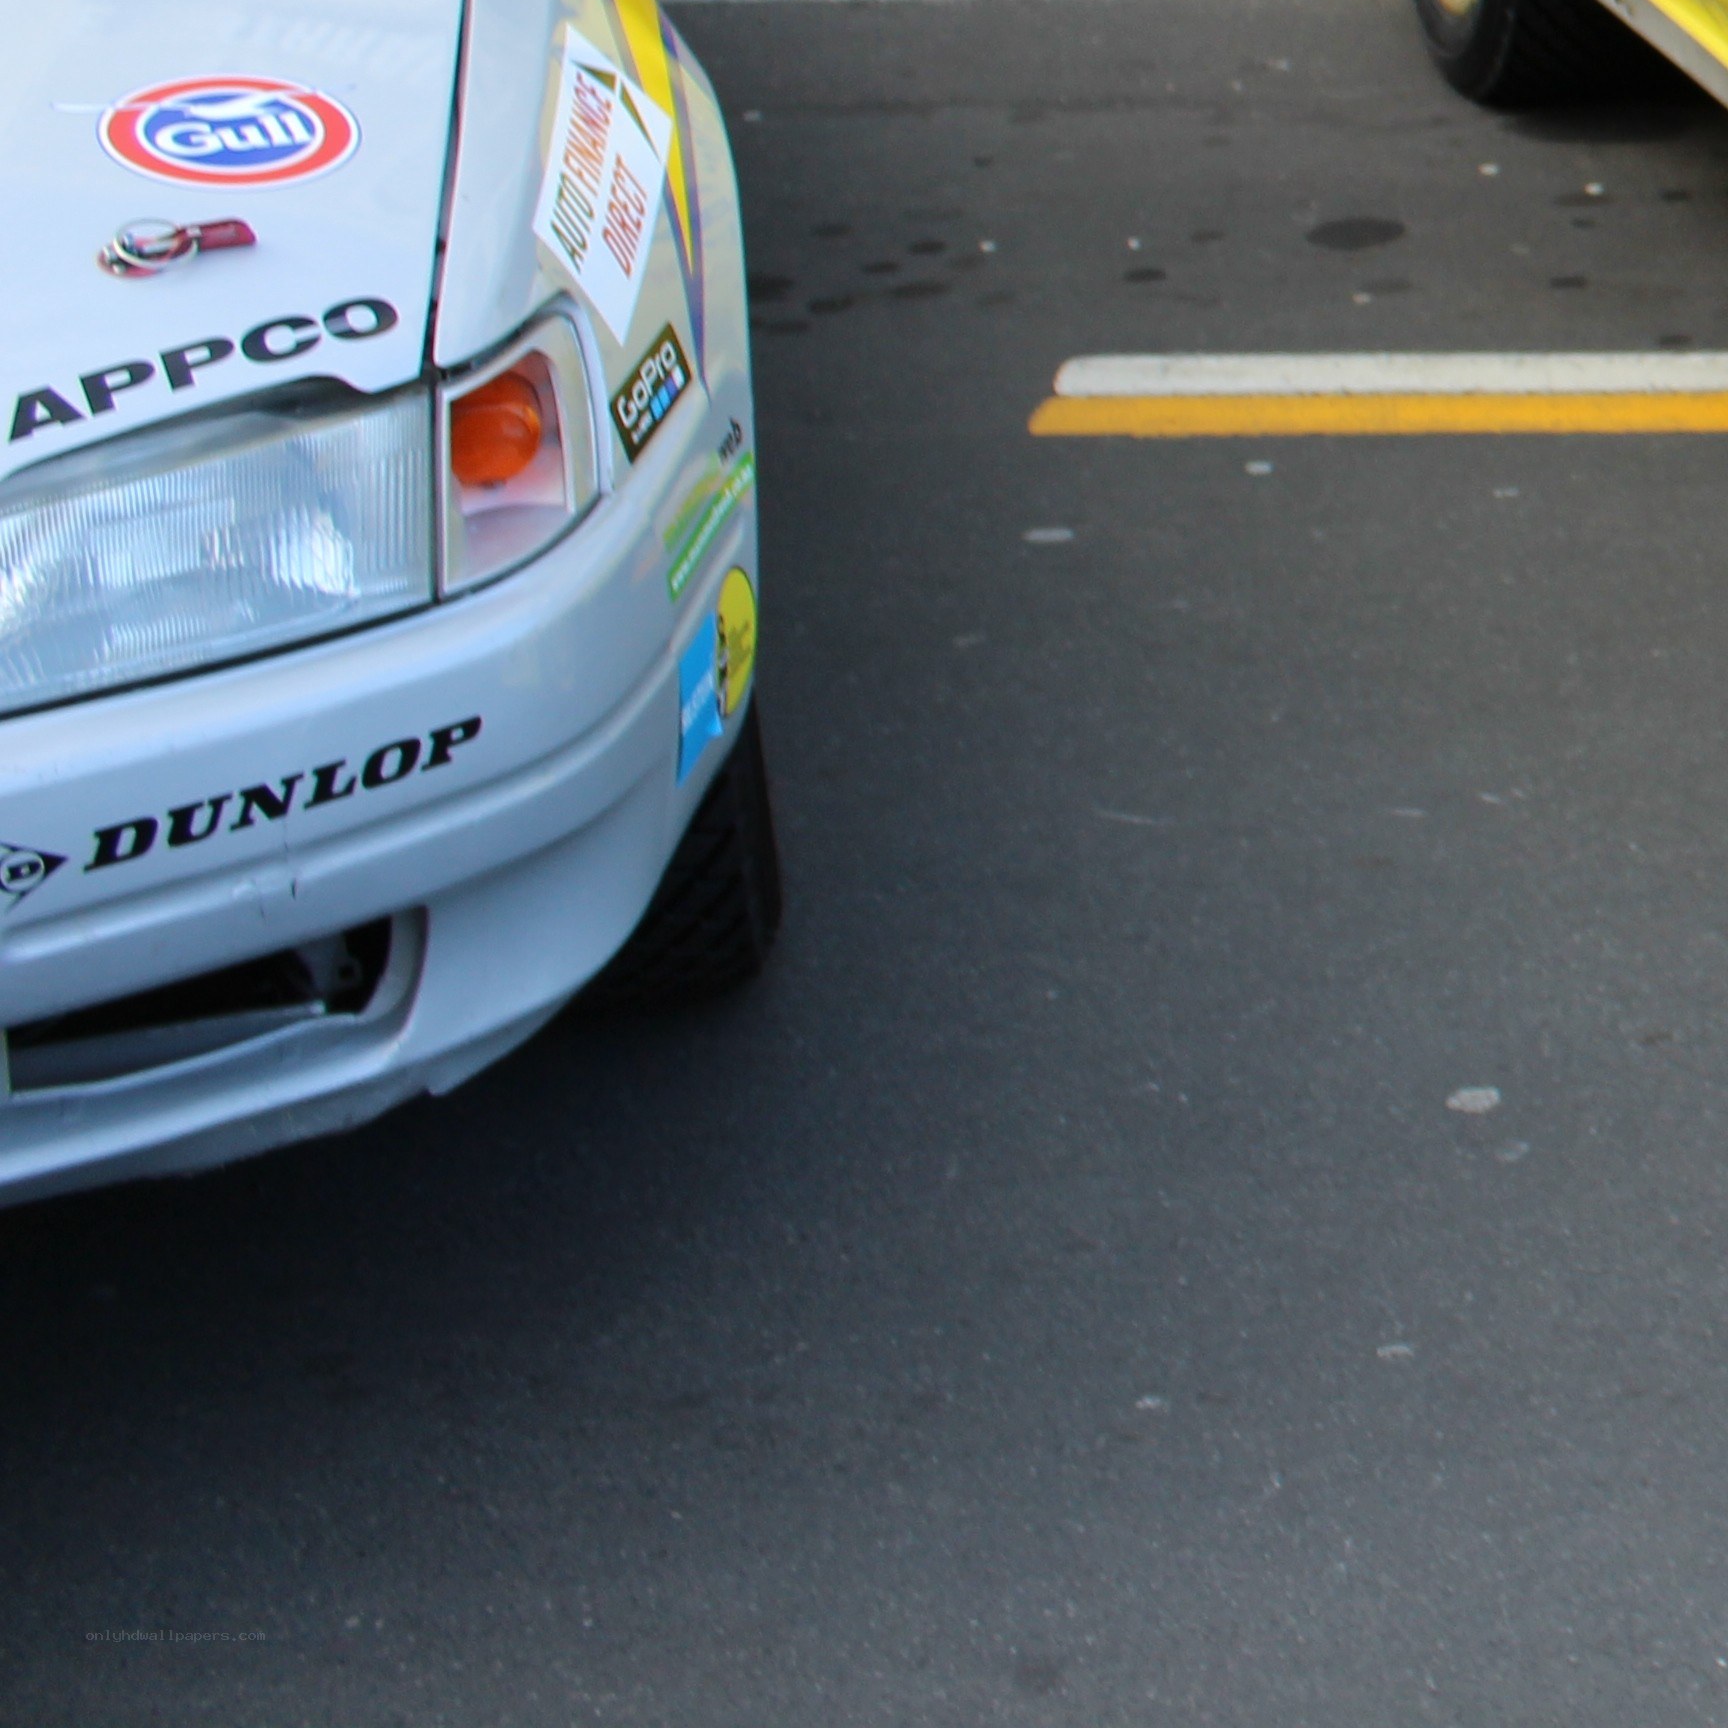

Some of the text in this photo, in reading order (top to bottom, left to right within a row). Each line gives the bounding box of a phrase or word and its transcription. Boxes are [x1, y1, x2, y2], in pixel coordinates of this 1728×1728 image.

[154, 109, 313, 157] Gull
[549, 70, 620, 274] AUTO FINANCE
[600, 153, 651, 281] DIRECT
[8, 297, 399, 443] APPCO
[616, 340, 677, 430] GoPro
[83, 714, 483, 872] DUNLOP
